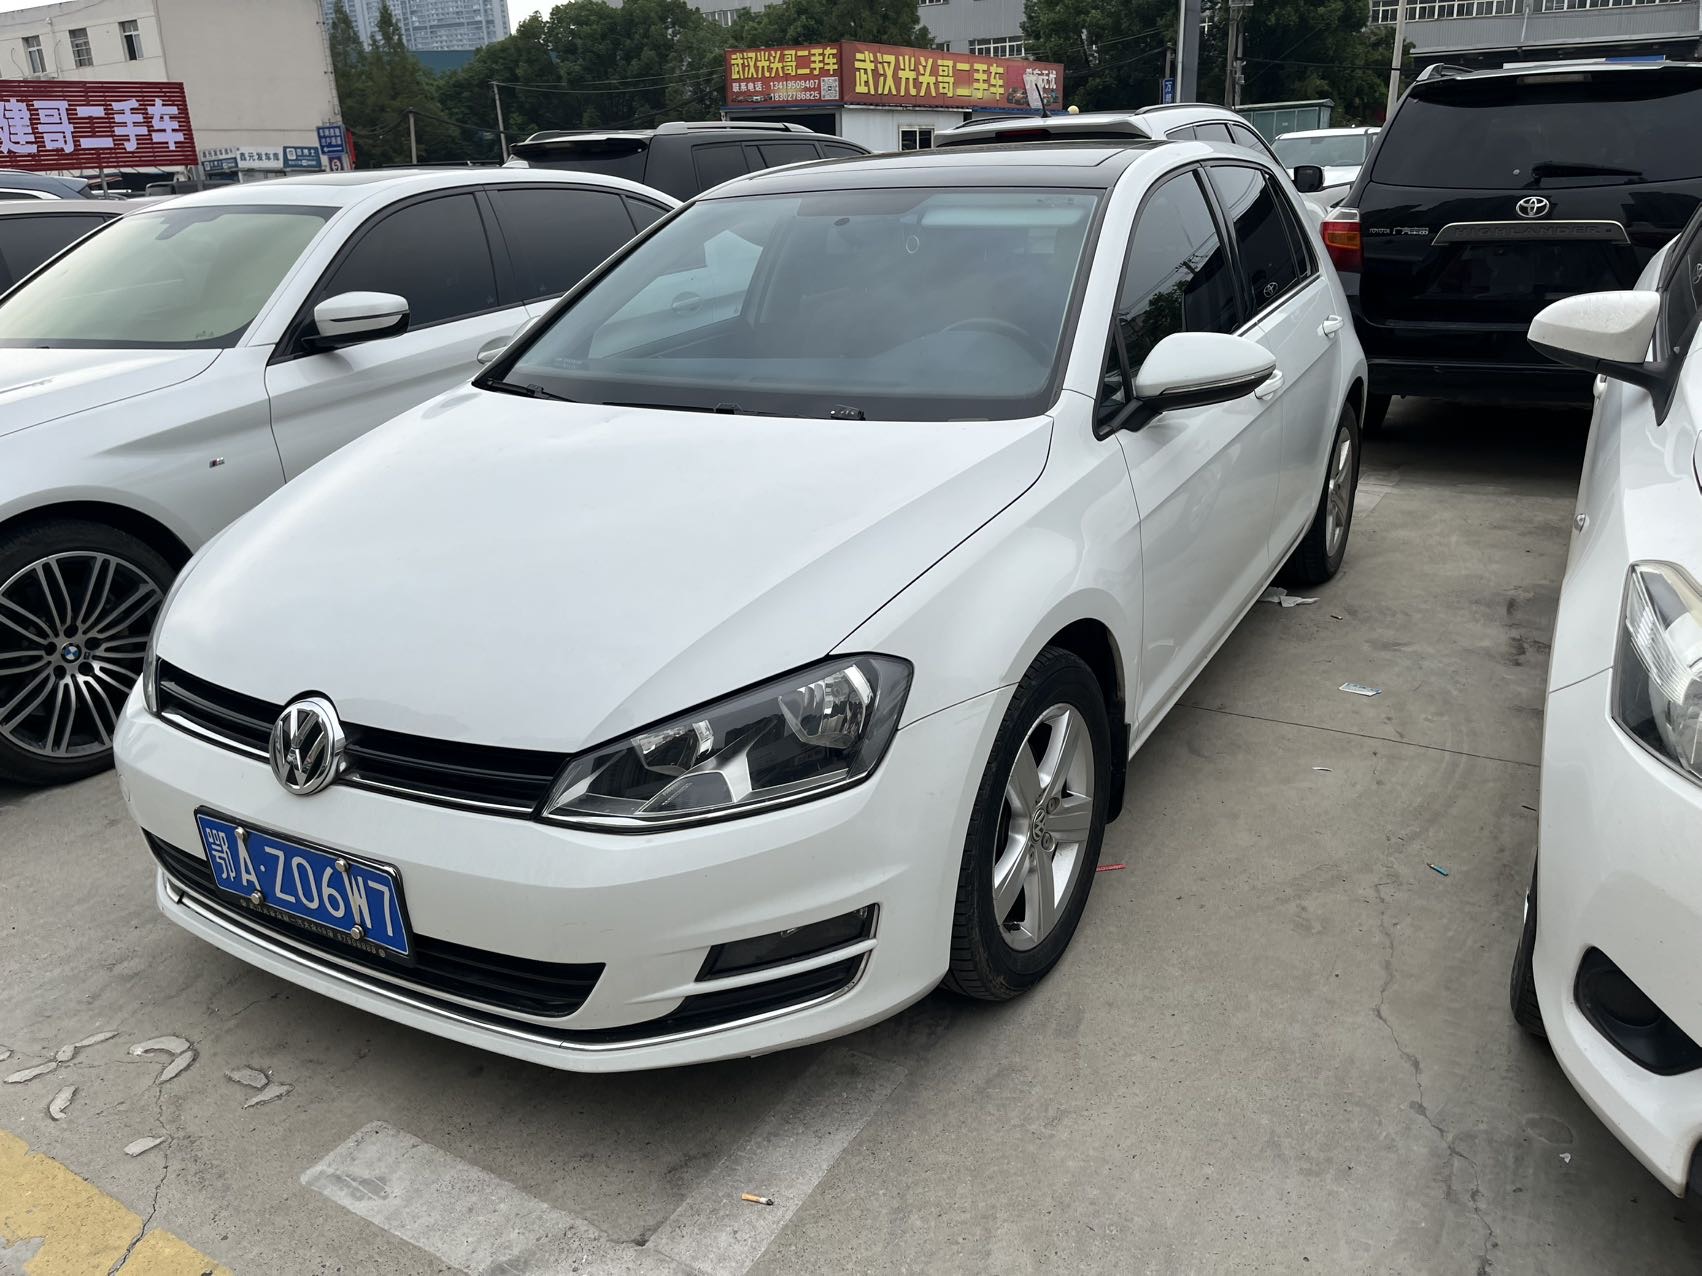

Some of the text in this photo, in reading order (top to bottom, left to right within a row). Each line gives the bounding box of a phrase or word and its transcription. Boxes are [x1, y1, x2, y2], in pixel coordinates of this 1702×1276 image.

[731, 47, 838, 79] 武汉光头哥二手车
[854, 50, 1005, 100] 武汉光头哥二手车
[1455, 225, 1601, 236] HIGHLANDER
